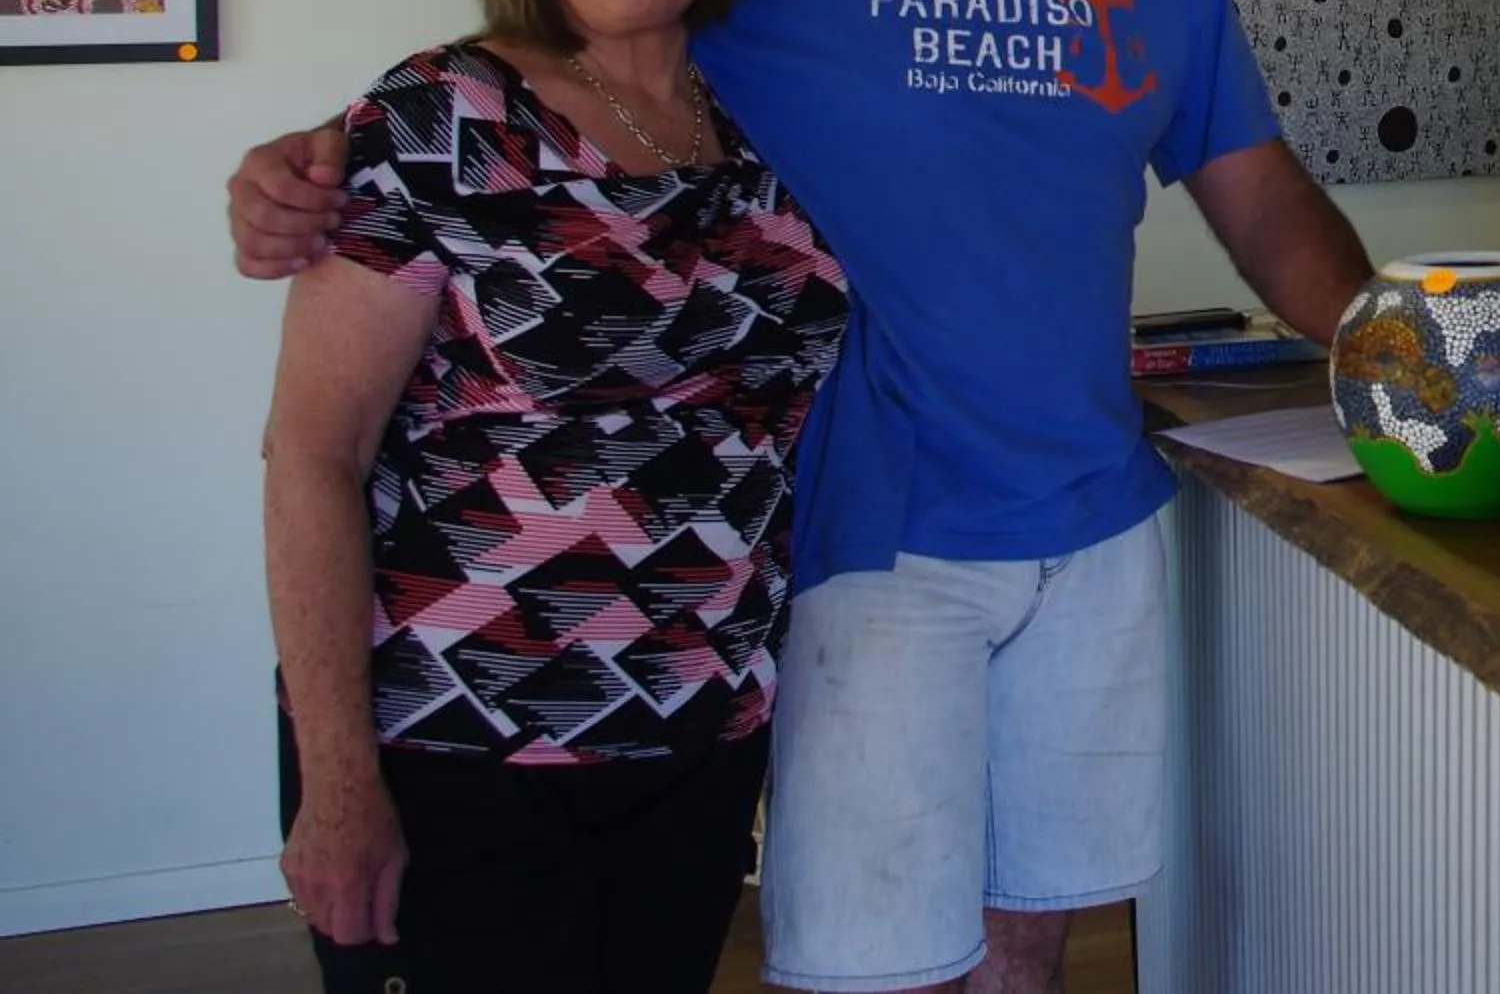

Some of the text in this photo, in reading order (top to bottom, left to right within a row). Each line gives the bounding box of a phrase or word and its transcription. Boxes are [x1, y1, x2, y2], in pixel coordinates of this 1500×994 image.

[913, 27, 1062, 71] BEACH
[907, 68, 1072, 98] Baja California
